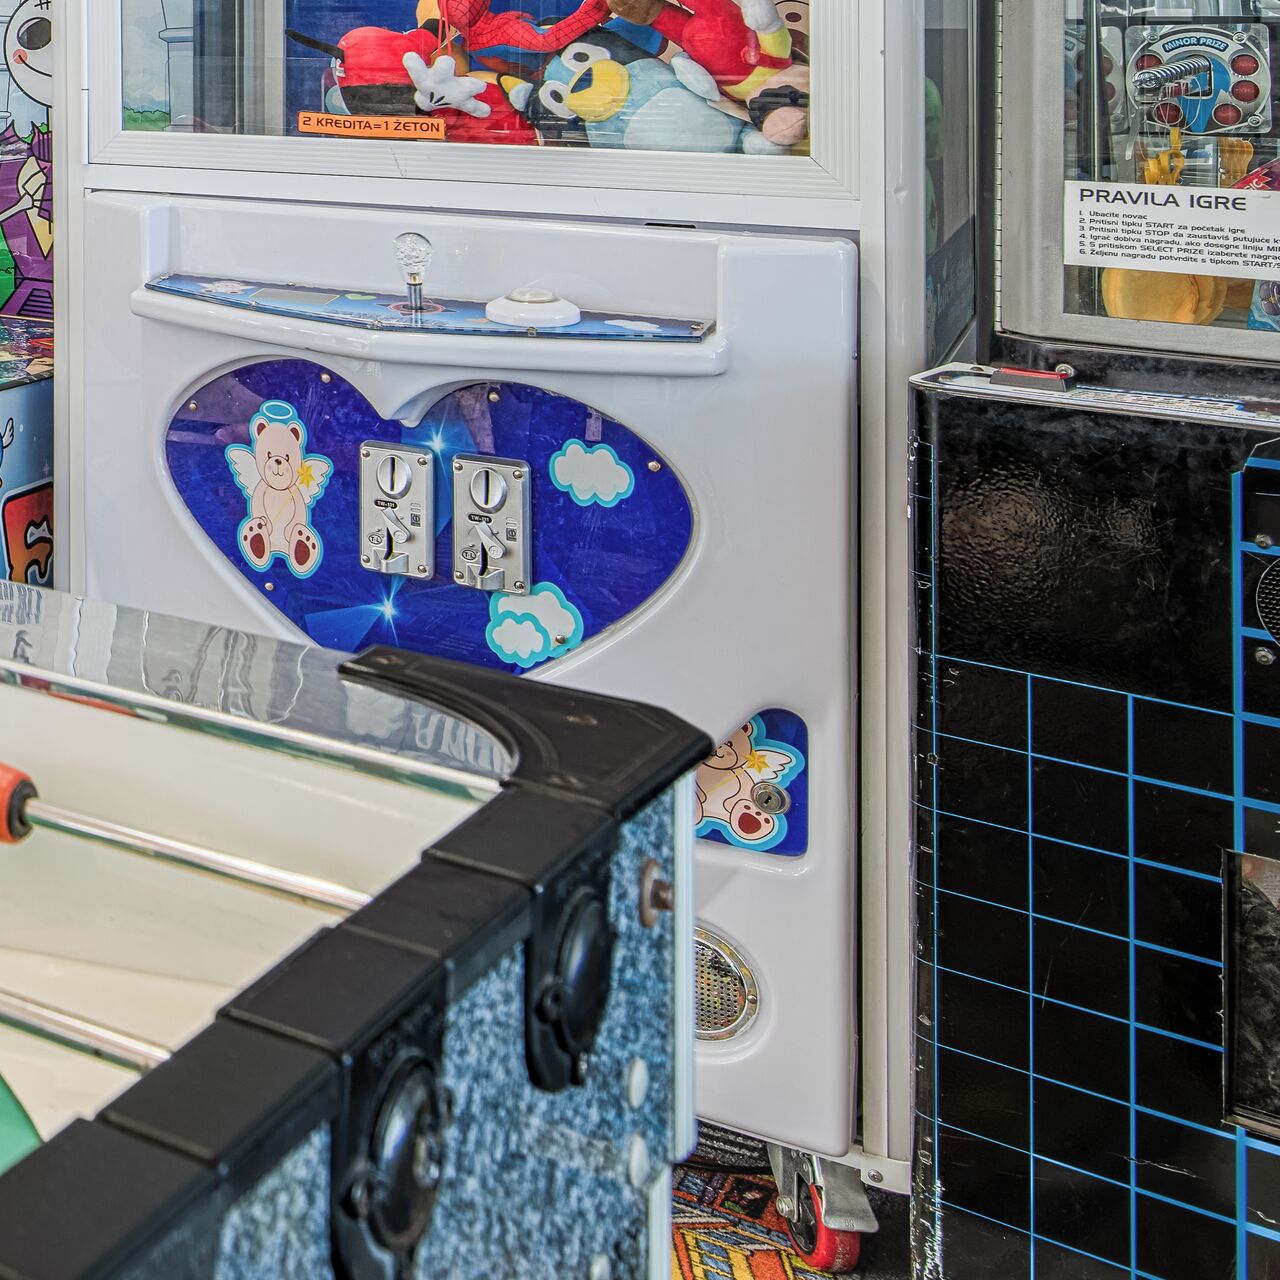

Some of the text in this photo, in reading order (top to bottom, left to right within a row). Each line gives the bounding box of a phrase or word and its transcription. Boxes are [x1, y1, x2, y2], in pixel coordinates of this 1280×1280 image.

[1165, 36, 1227, 52] MINOR PRIZE
[303, 116, 440, 132] 2 KREDITA=1 ŽETON
[1079, 188, 1247, 211] PRAVILA IGRE
[1089, 210, 1119, 218] Ubacite
[1089, 218, 1118, 226] Pritisni
[1122, 220, 1142, 228] tipku
[1098, 242, 1137, 251] pritiskom
[1140, 245, 1174, 253] SELECT
[1177, 247, 1205, 255] PRIZE
[1208, 250, 1248, 258] izaberete
[1114, 235, 1141, 243] dobiva
[1204, 241, 1239, 250] dosegne
[1243, 244, 1264, 252] liniju
[1090, 248, 1118, 257] Željenu
[1121, 251, 1156, 260] nagradu
[1159, 255, 1198, 263] potvrdite
[1210, 258, 1240, 266] tipkom
